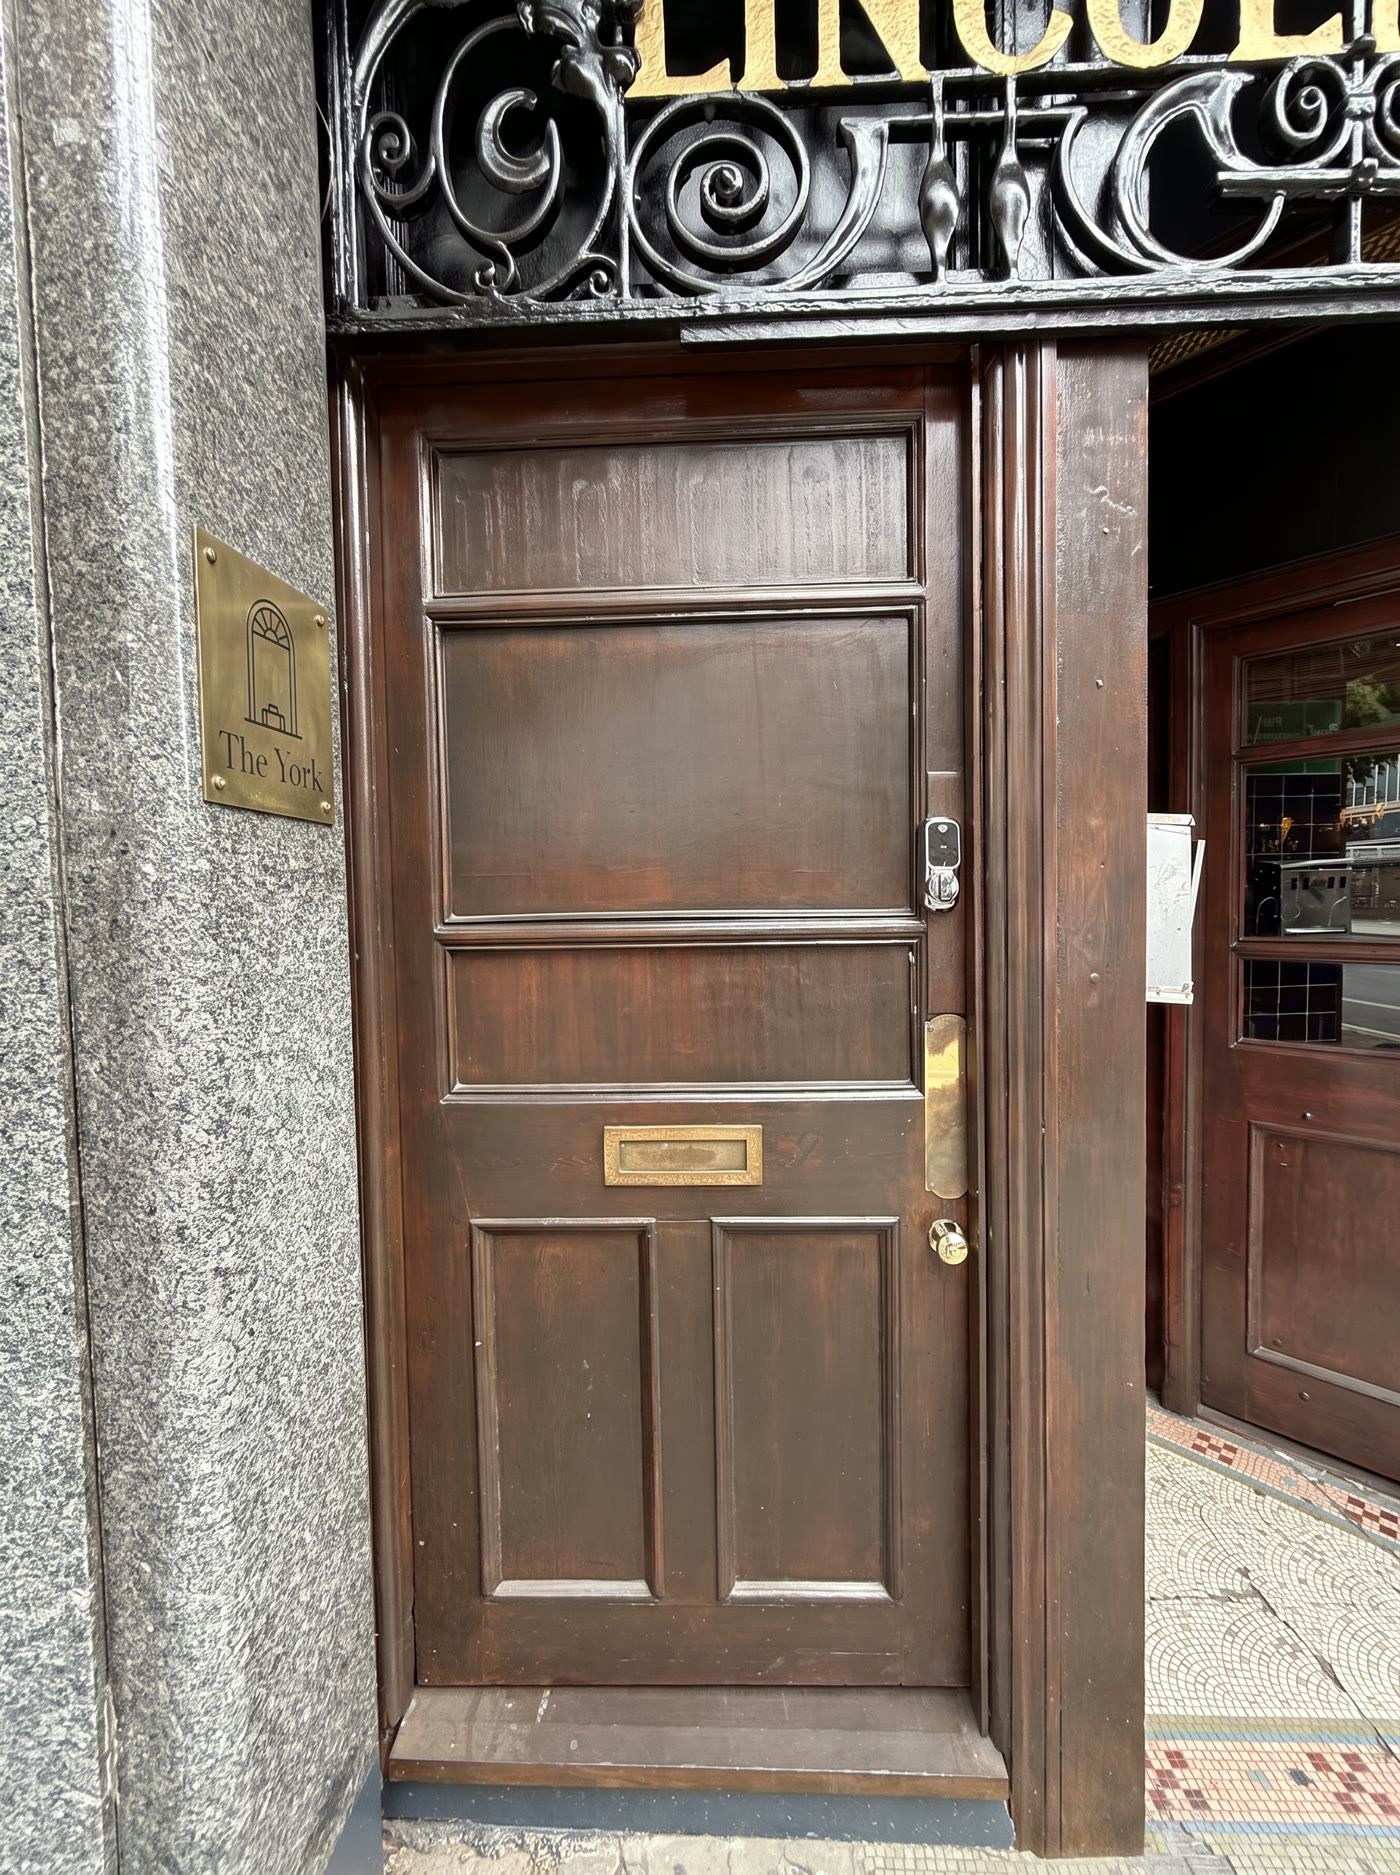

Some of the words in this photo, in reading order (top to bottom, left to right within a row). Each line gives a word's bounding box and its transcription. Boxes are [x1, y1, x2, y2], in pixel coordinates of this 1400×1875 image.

[624, 0, 1400, 98] LINCOL
[219, 730, 268, 778] The
[273, 747, 324, 792] York
